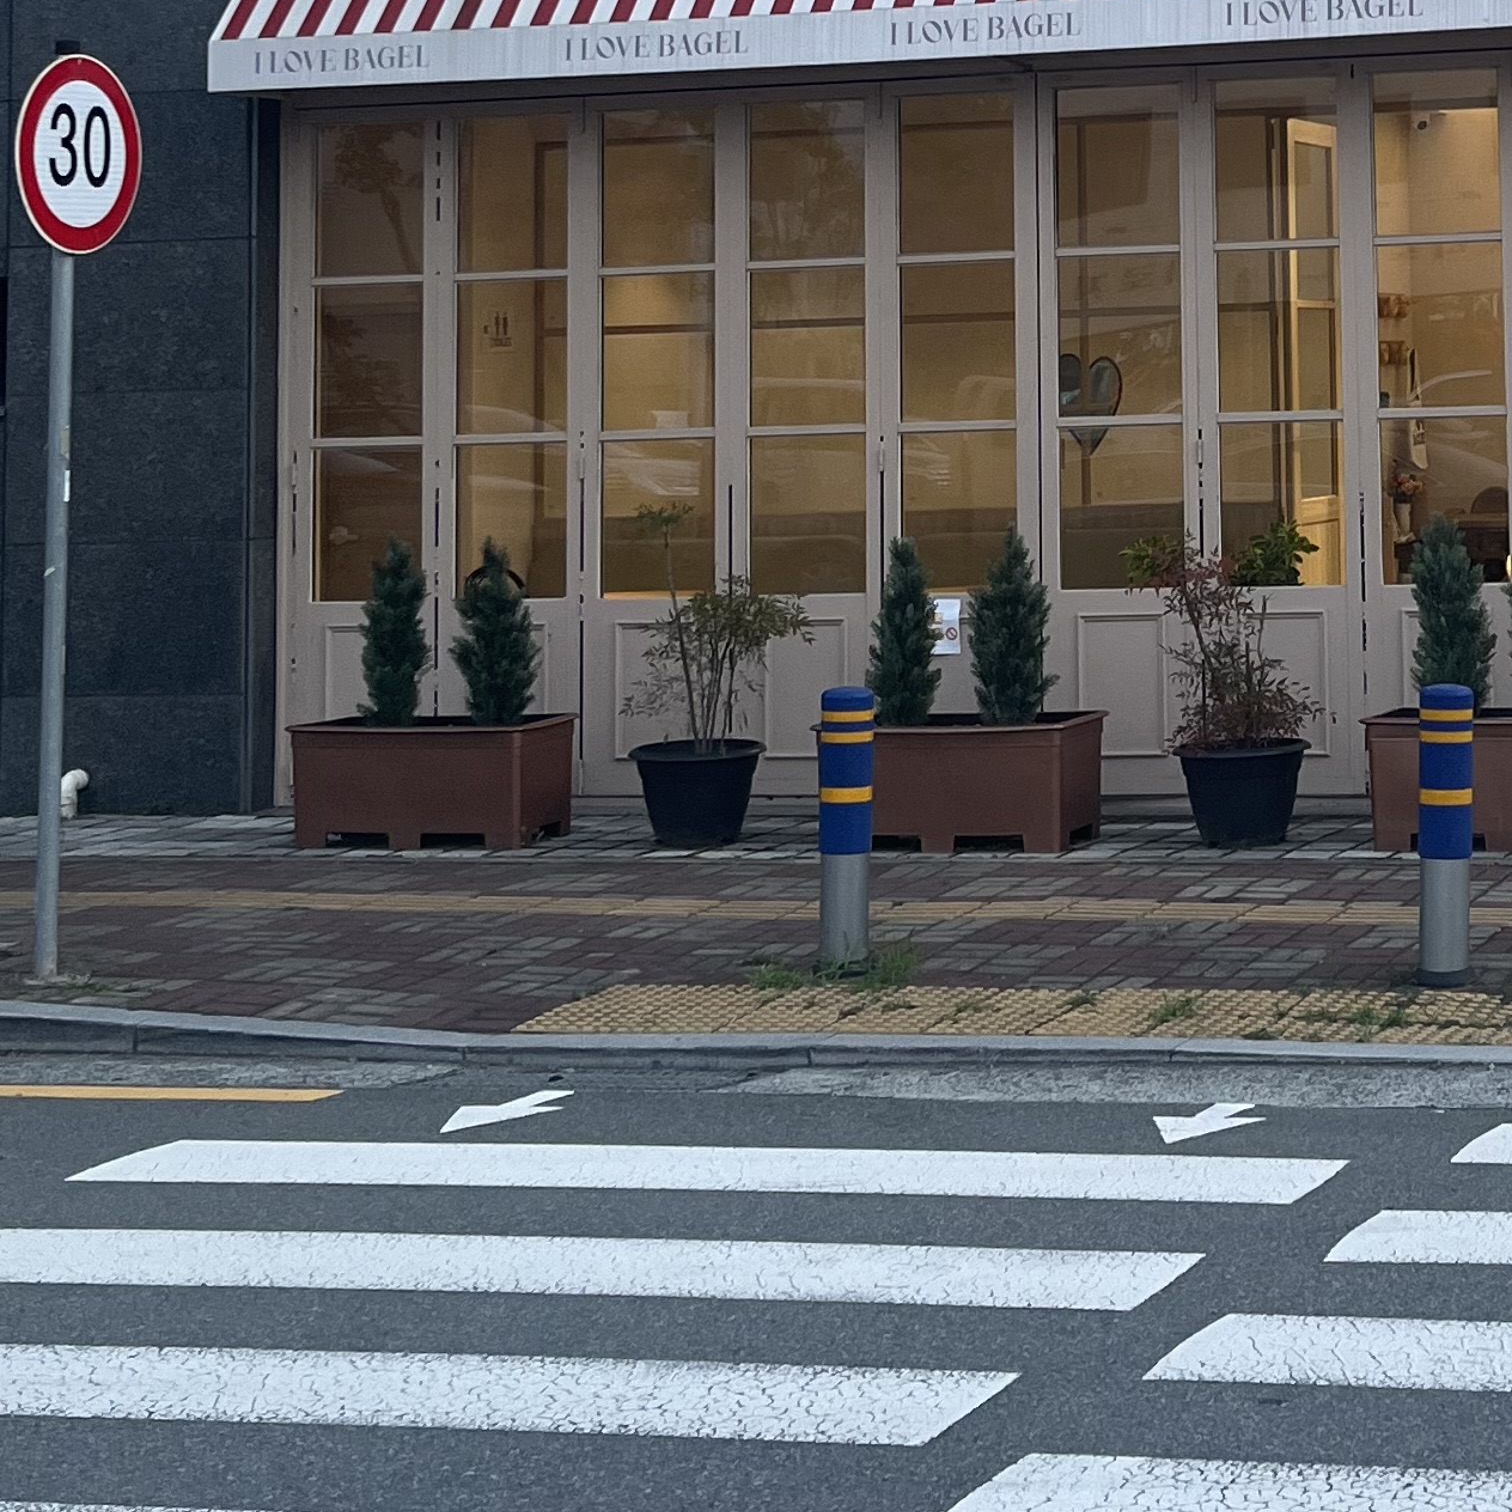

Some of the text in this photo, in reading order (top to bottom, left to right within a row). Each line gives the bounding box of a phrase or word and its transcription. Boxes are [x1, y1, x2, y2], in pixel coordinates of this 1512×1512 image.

[907, 18, 979, 45] LOVE
[987, 12, 1081, 41] BAGEL
[270, 48, 337, 74] LOVE
[345, 44, 430, 71] BAGEL
[581, 34, 650, 61] LOVE
[659, 30, 749, 58] BAGEL
[49, 103, 111, 188] 30
